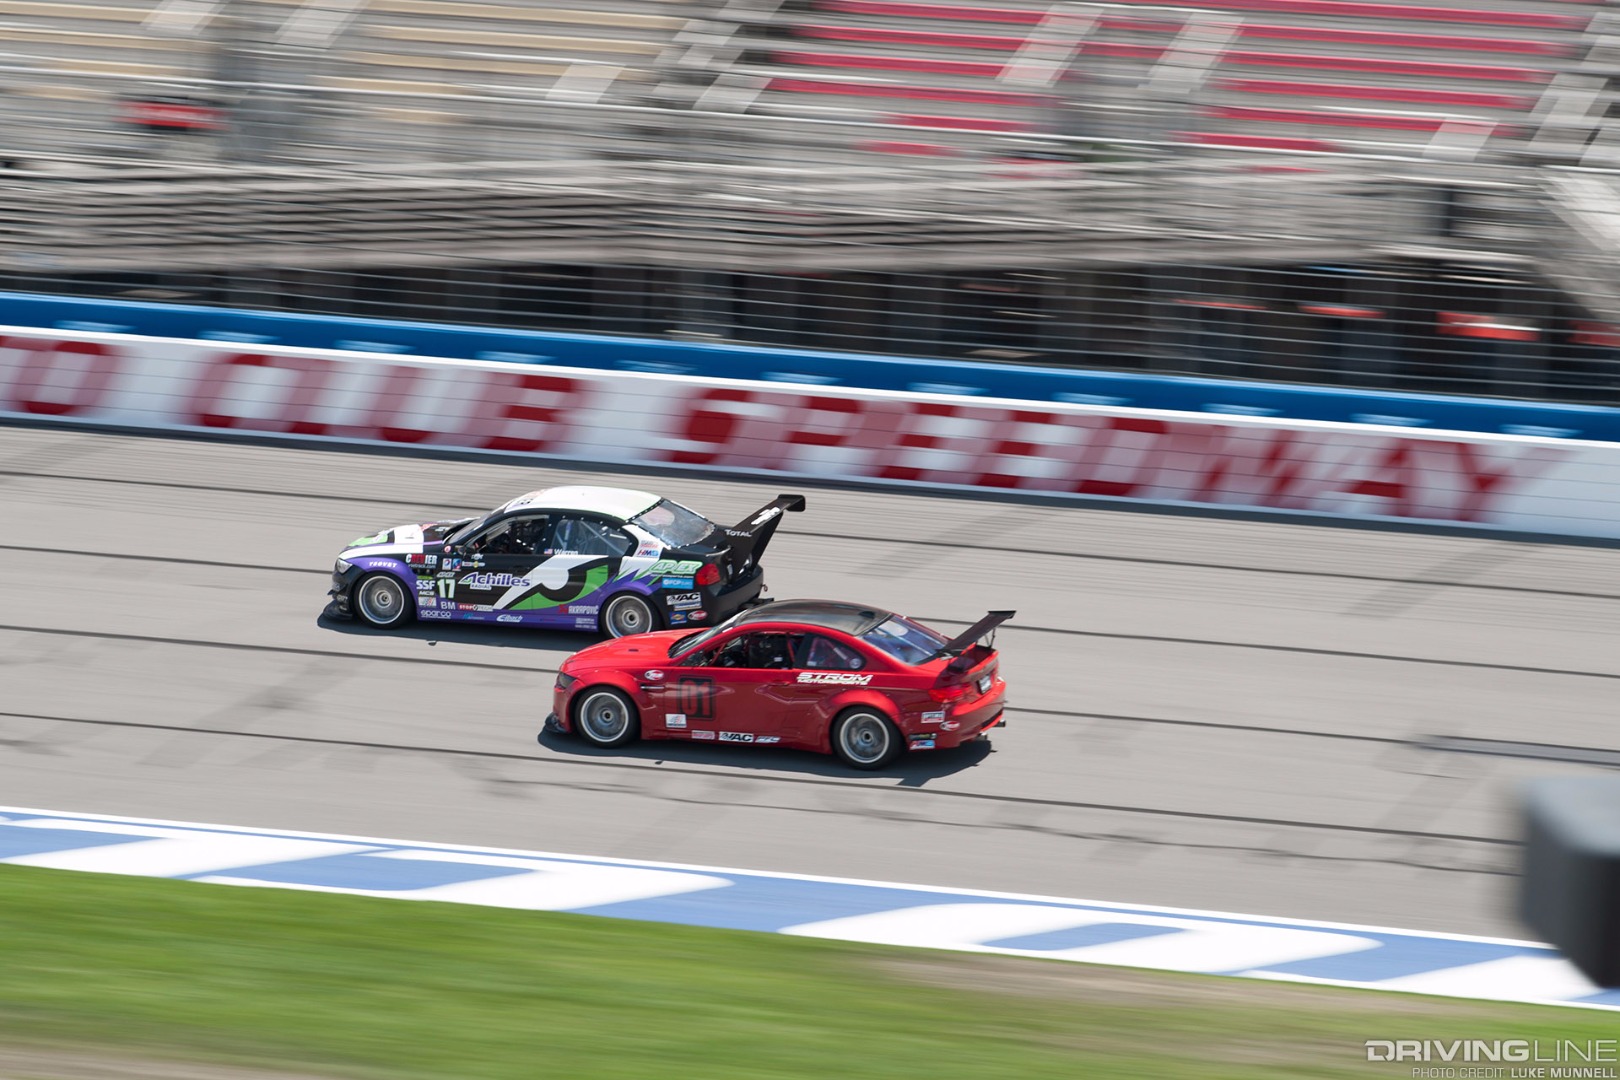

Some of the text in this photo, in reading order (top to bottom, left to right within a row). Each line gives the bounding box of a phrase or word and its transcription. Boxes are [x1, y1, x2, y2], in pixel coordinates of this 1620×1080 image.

[186, 351, 595, 454] CLUB
[662, 386, 1568, 524] SPEEDWAY
[725, 529, 752, 537] TOTAL
[416, 580, 436, 590] SSF
[458, 571, 531, 587] Achilles
[437, 579, 456, 599] 17
[421, 610, 451, 618] sparco
[797, 672, 873, 682] STROM
[682, 680, 712, 717] 01
